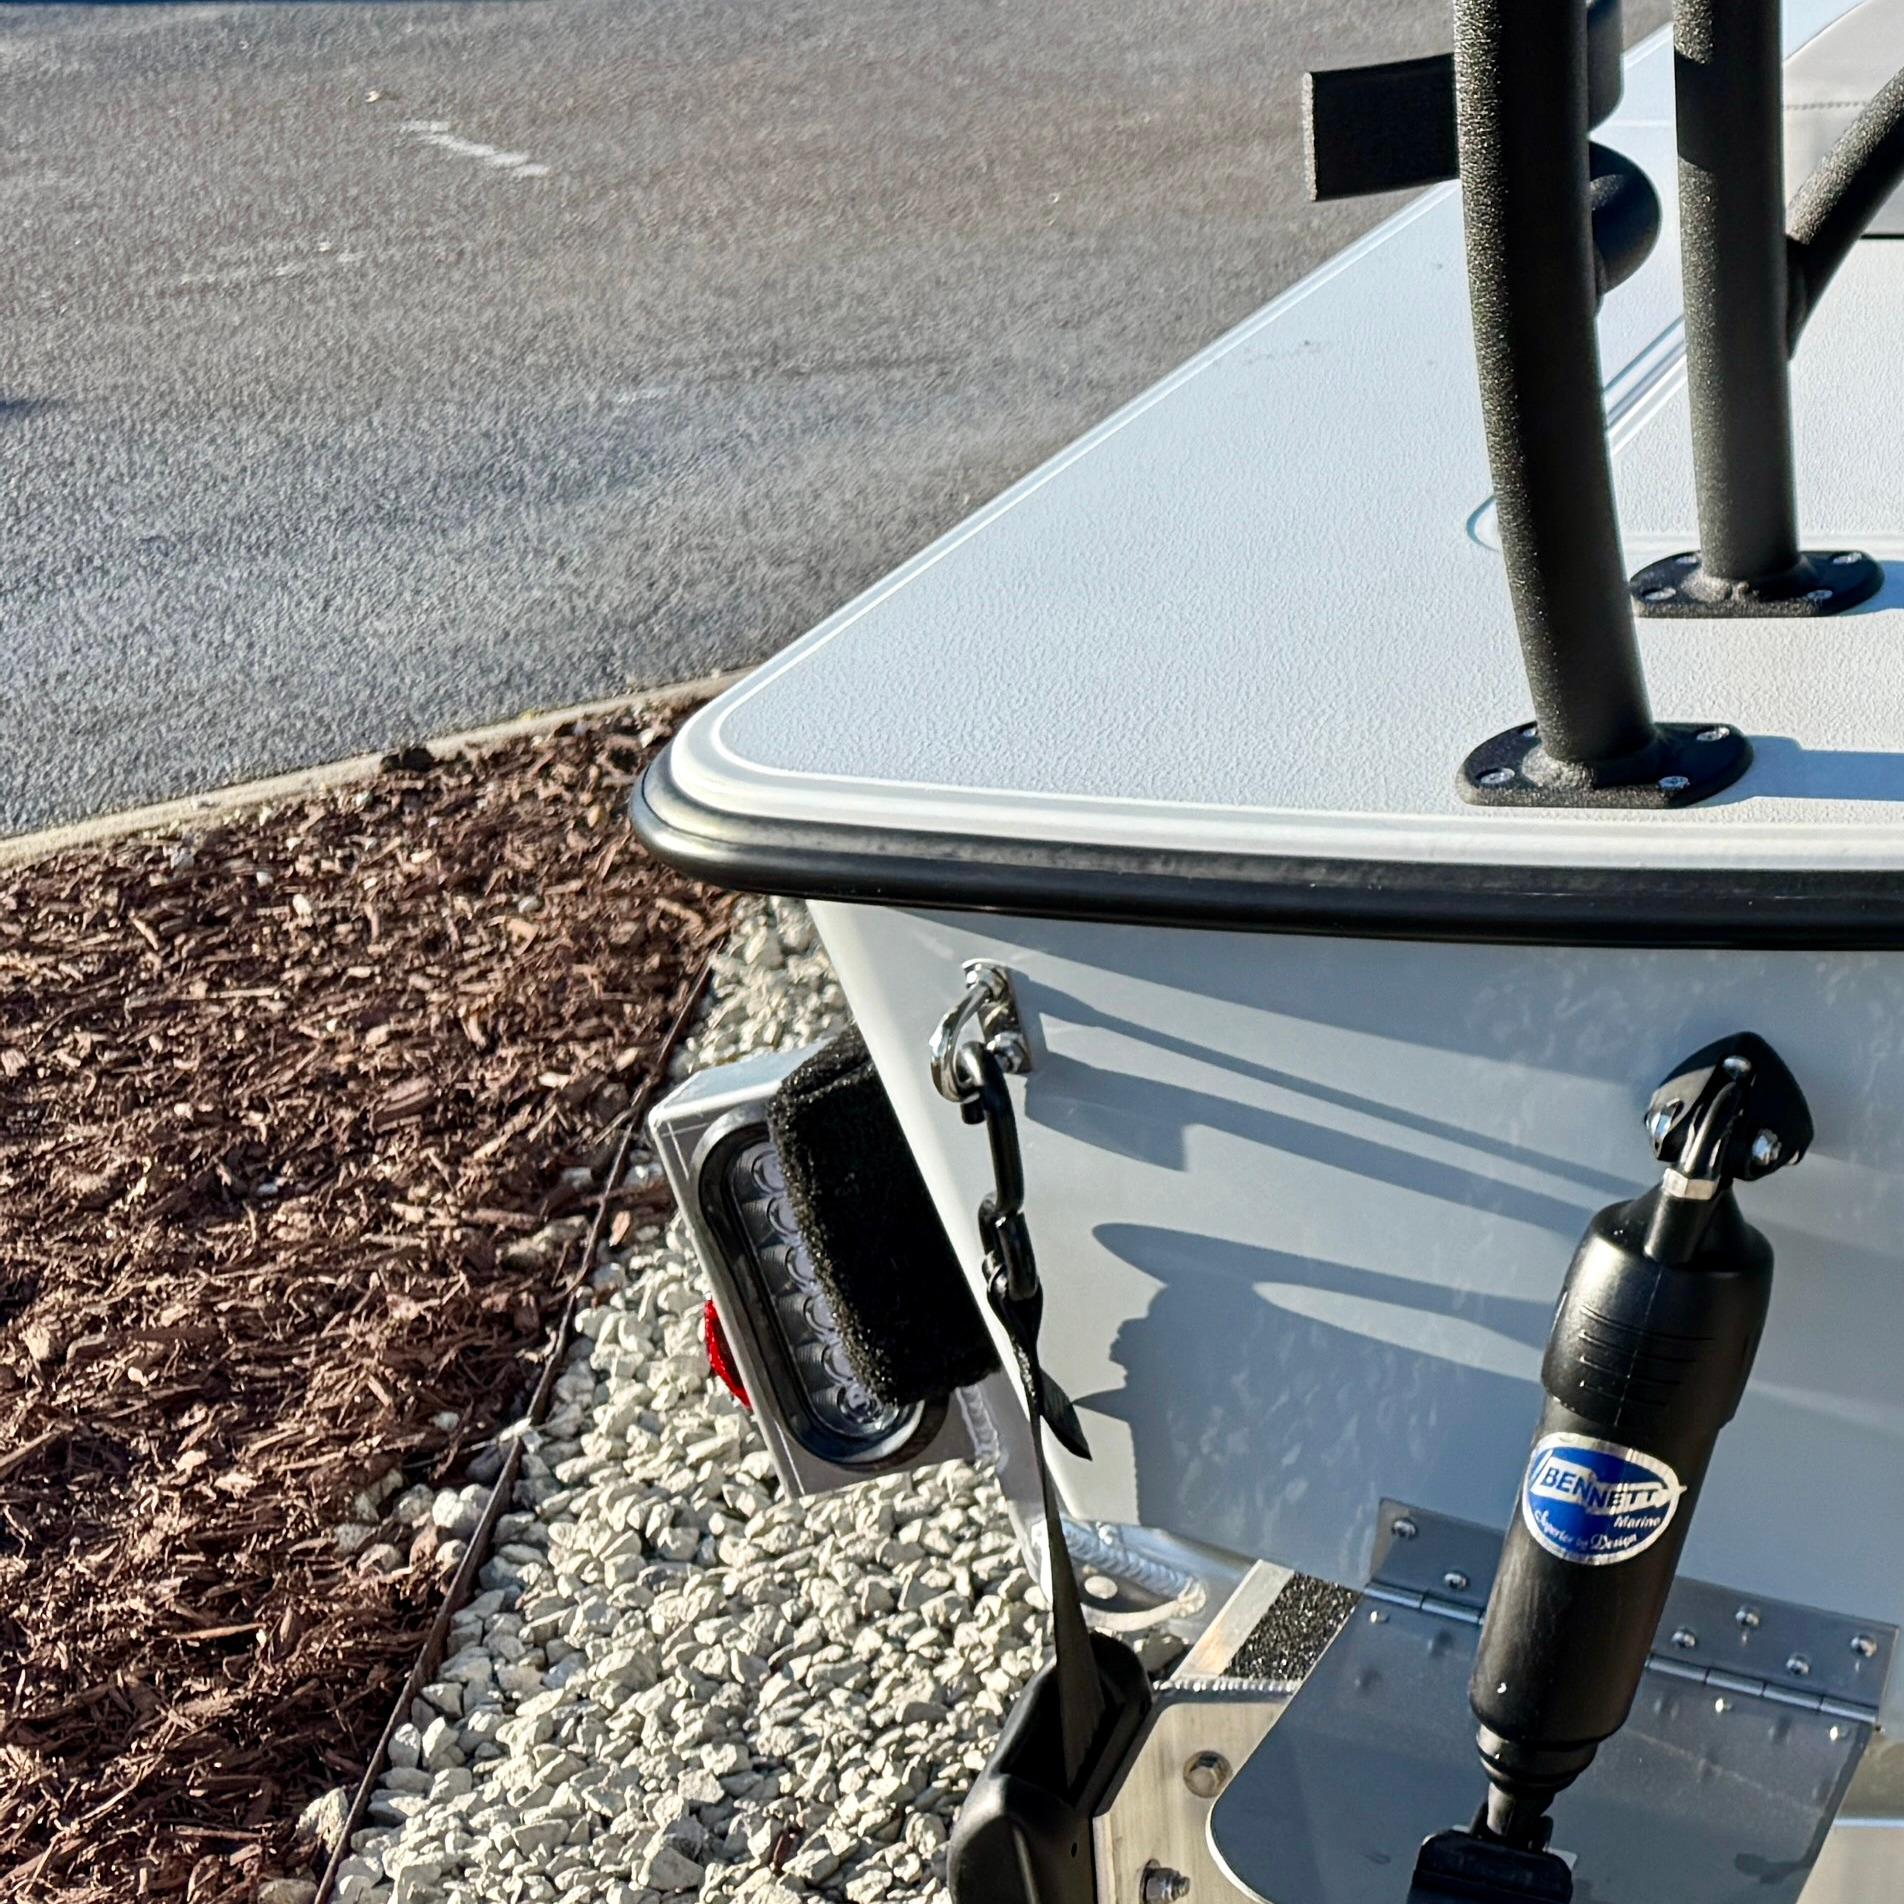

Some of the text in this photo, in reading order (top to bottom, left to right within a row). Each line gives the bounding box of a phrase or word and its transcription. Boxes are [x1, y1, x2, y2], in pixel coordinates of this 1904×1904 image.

[1539, 1465, 1659, 1510] BENNETT
[1613, 1514, 1662, 1530] Marine
[1589, 1532, 1638, 1551] Design
